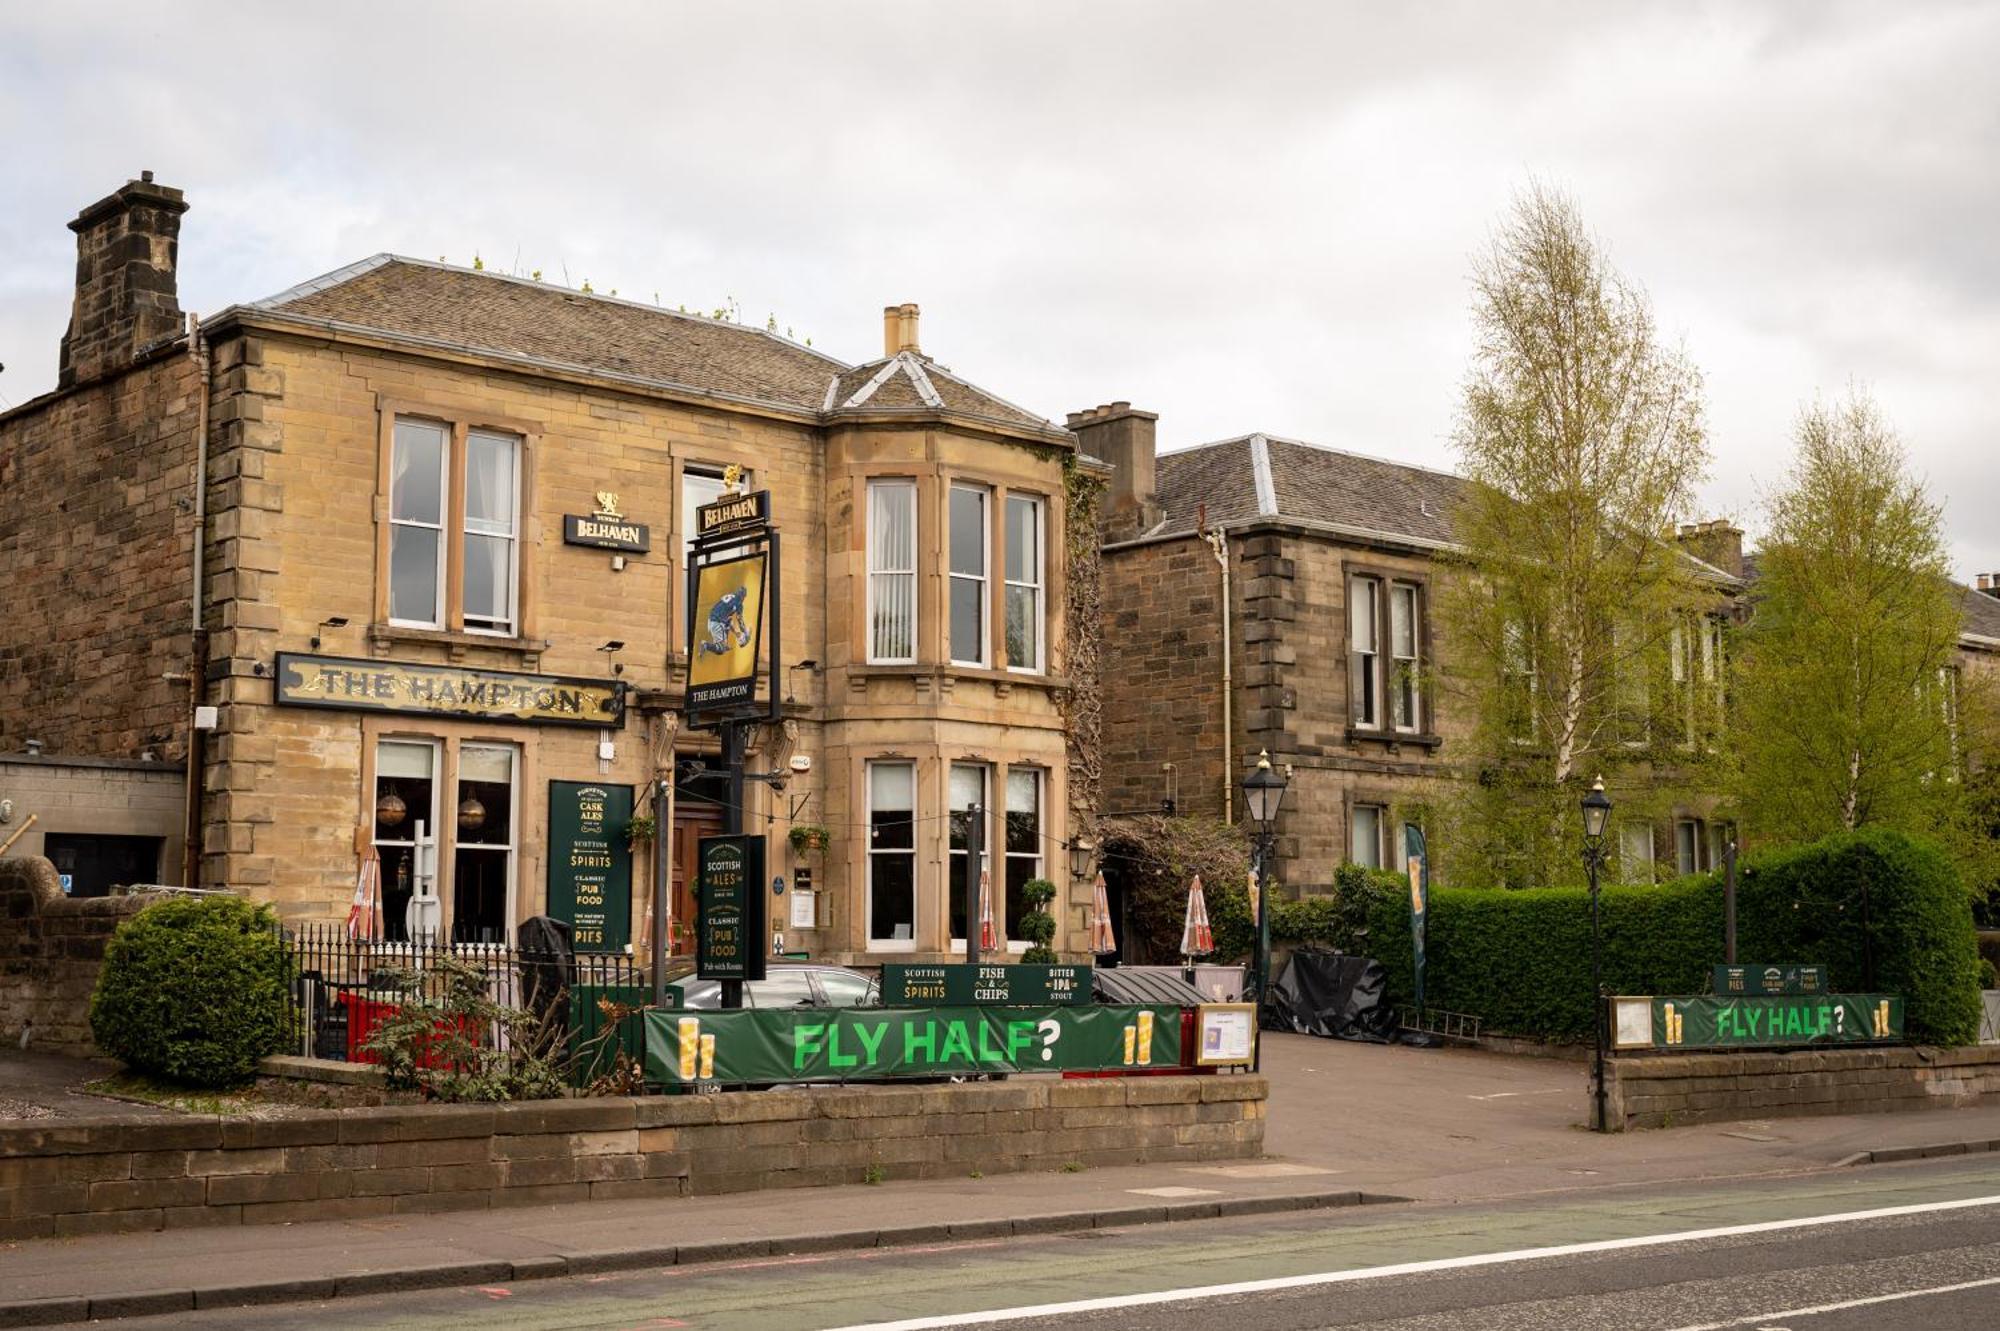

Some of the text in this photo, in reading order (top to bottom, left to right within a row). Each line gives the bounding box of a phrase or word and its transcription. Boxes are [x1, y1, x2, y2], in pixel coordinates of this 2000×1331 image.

[704, 497, 757, 529] BELHAVEN
[577, 519, 640, 545] BELHAVEN
[319, 668, 580, 713] THE HAMPTON
[692, 684, 748, 702] THE HAMPTON
[580, 802, 603, 811] CASK
[580, 811, 603, 821] ALES
[570, 855, 612, 868] SPIRITS
[707, 860, 741, 871] SCOTTISH
[712, 873, 736, 885] ALES
[581, 884, 599, 894] PUB
[576, 895, 603, 905] FOOD
[708, 917, 740, 925] CLASSIC
[575, 930, 603, 943] PIES
[714, 930, 732, 941] PUB
[710, 945, 736, 957] FOOD
[904, 969, 946, 978] SCOTTISH
[979, 967, 1006, 980] FISH
[1048, 968, 1075, 978] BITTER
[988, 980, 996, 988] &
[1053, 978, 1071, 991] IPA
[904, 986, 946, 999] SPIRITS
[974, 989, 1010, 1001] CHIPS
[1049, 992, 1073, 1000] STOUT
[1716, 1004, 1846, 1037] FLY HALF?
[793, 1018, 1061, 1069] FLY HALF?
